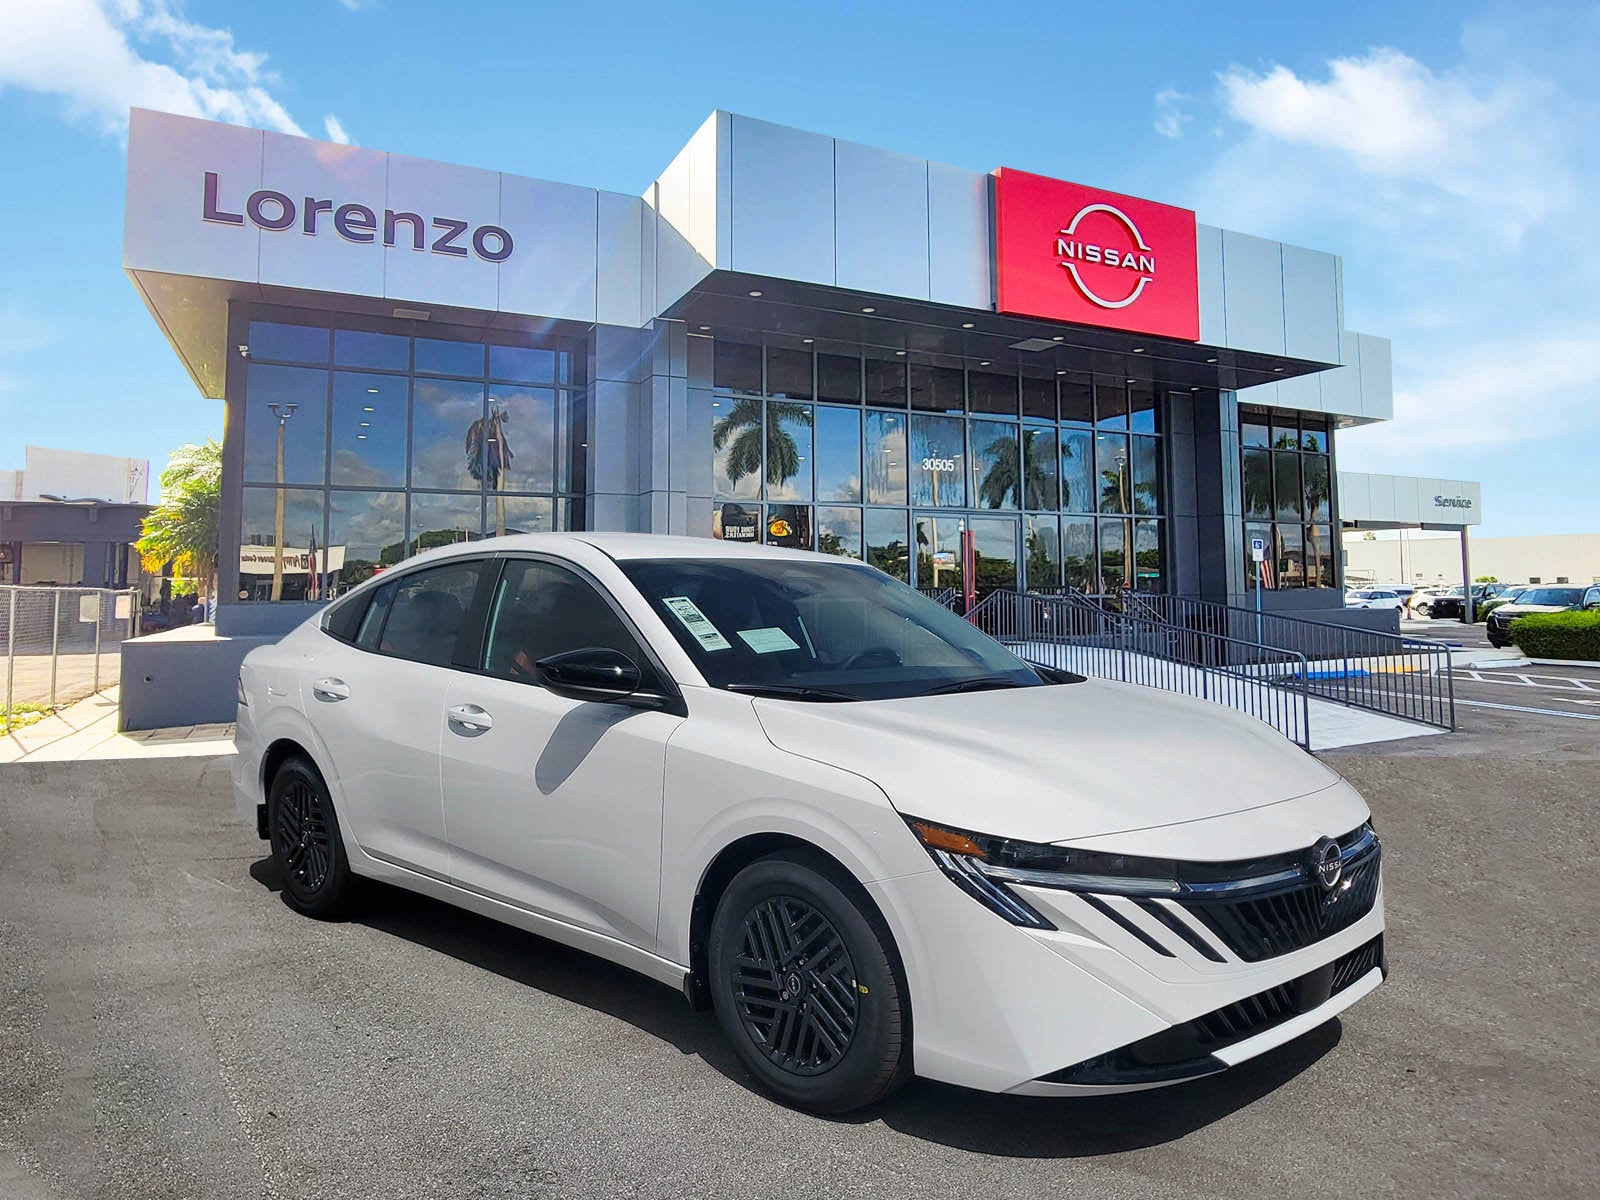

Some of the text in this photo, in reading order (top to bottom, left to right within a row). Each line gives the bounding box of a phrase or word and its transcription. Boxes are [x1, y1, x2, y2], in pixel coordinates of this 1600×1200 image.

[202, 171, 514, 262] Lorenzo
[1057, 238, 1155, 273] NISSAN
[922, 458, 954, 471] 30505
[1434, 496, 1472, 508] Service
[1319, 861, 1340, 873] NISS
